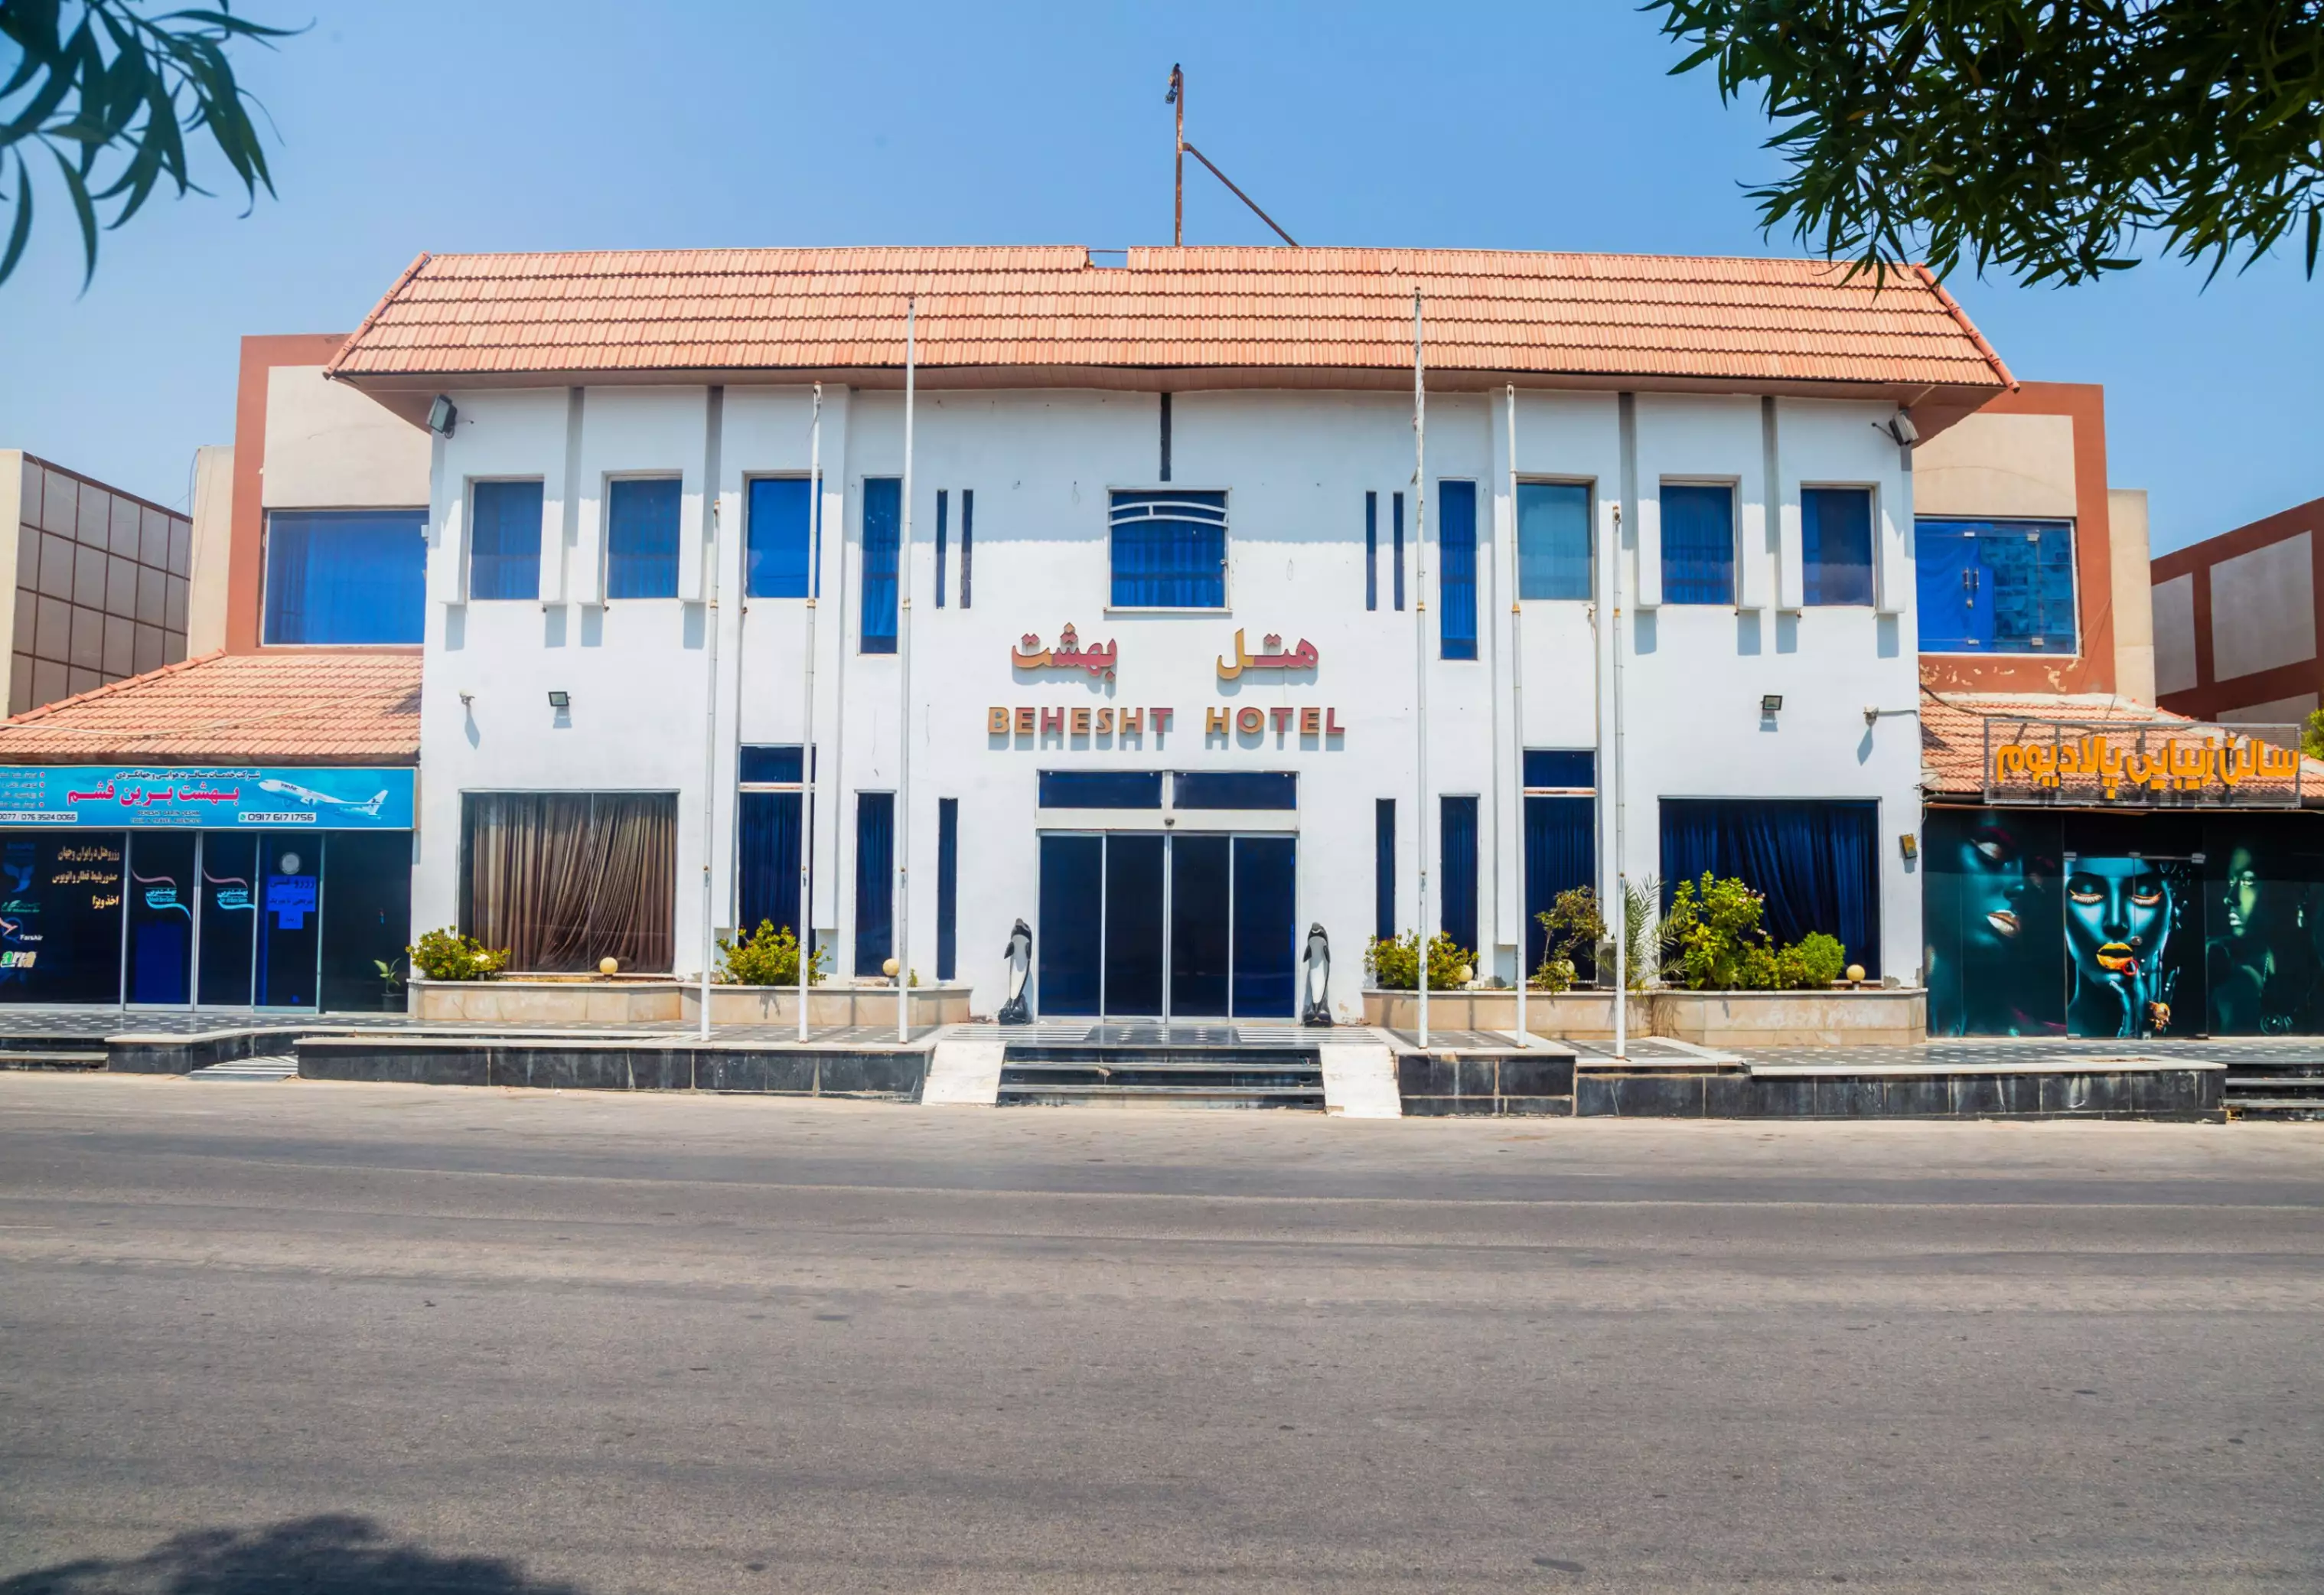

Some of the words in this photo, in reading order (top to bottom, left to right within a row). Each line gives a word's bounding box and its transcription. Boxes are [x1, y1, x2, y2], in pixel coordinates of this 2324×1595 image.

[1011, 621, 1117, 682] بهشت
[1217, 628, 1319, 680] هتل
[987, 706, 1173, 735] BEHESHT
[1205, 706, 1345, 735] HOTEL
[1996, 736, 2122, 799] پالادیوم
[2127, 736, 2215, 791] زیبایی
[2221, 736, 2299, 786] سالن
[116, 770, 151, 780] جهانگردی
[209, 771, 235, 779] خدمات
[236, 771, 260, 780] شرکت
[67, 779, 115, 805] قشم
[119, 786, 173, 807] برین
[178, 781, 240, 806] بهشت
[92, 895, 105, 909] ویزا
[105, 894, 119, 905] اخذ
